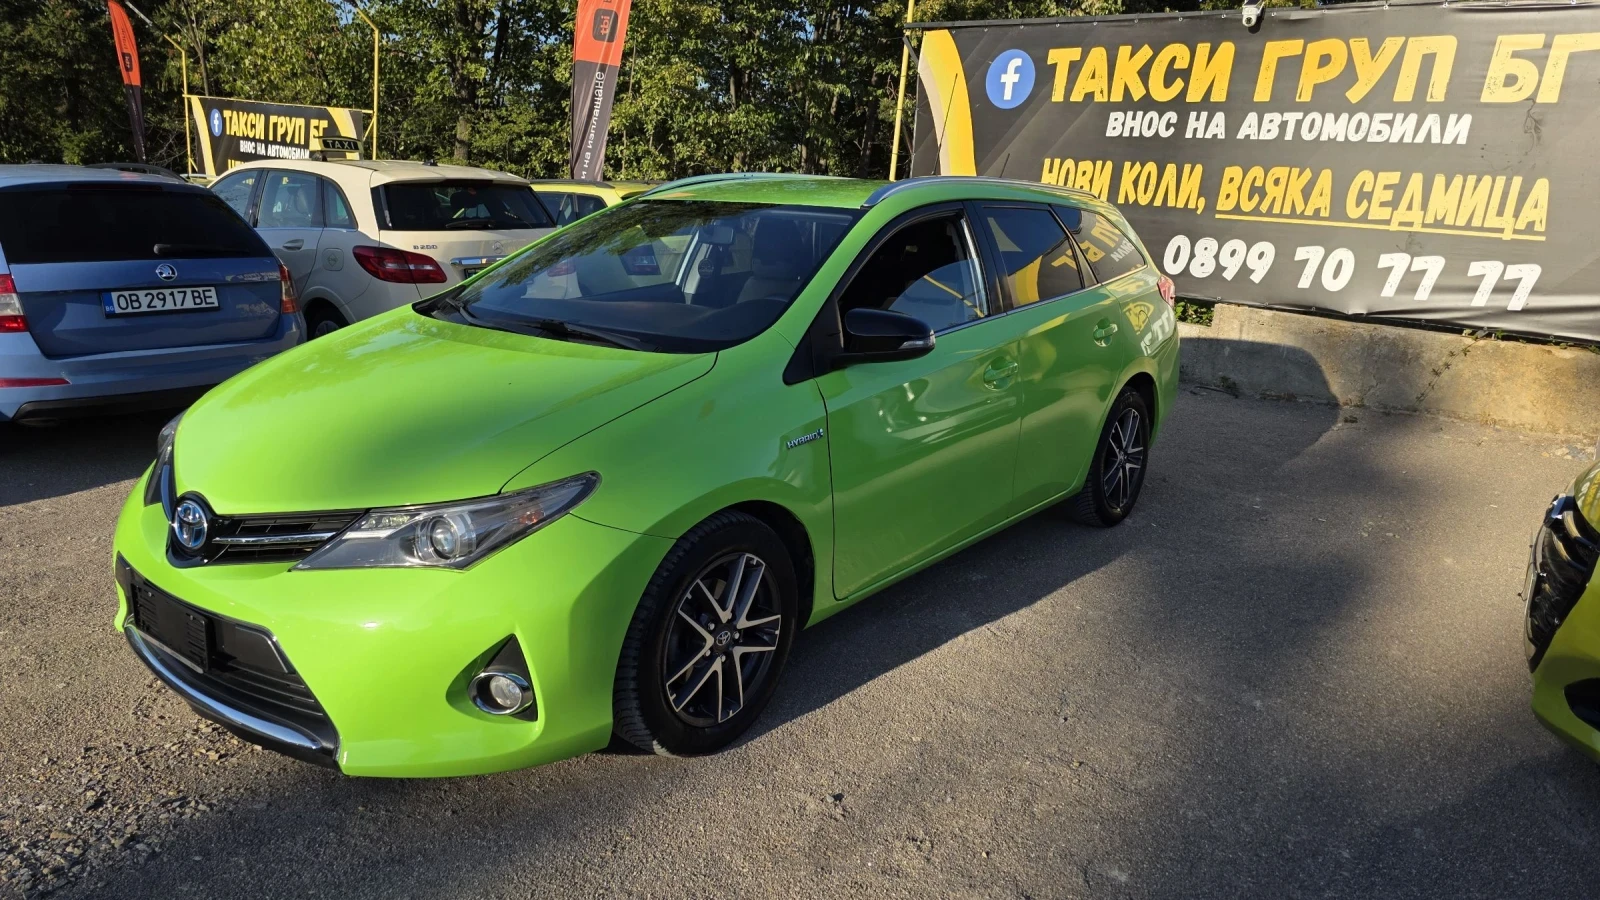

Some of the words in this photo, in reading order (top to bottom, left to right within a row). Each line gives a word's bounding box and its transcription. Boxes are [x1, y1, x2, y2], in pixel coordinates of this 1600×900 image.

[600, 15, 610, 35] tbi
[1047, 41, 1235, 102] ТАКСИ
[1253, 35, 1457, 104] ГРУП
[1480, 32, 1600, 103] БГ
[223, 110, 265, 140] ТАКСИ
[269, 115, 305, 145] ГРУП
[583, 152, 591, 168] на
[587, 71, 605, 149] изплащане
[1106, 111, 1178, 138] ВНОС
[1185, 111, 1226, 139] НА
[1236, 112, 1472, 145] АВТОМОБИЛИ
[240, 140, 256, 154] ВНОС
[256, 142, 266, 156] НА
[267, 144, 310, 159] АВТОМОБИЛИ
[326, 140, 355, 150] TAXI
[1041, 158, 1113, 201] НОВИ
[1117, 161, 1206, 214] КОЛИ,
[1216, 166, 1332, 217] ВСЯКА
[1346, 170, 1549, 240] СЕДМИЦА
[1163, 235, 1276, 284] 0899
[1294, 246, 1355, 292] 70
[1377, 253, 1445, 300] 77
[1467, 261, 1542, 311] 77
[117, 293, 142, 310] OB
[146, 290, 187, 309] 2917
[191, 289, 215, 306] BE
